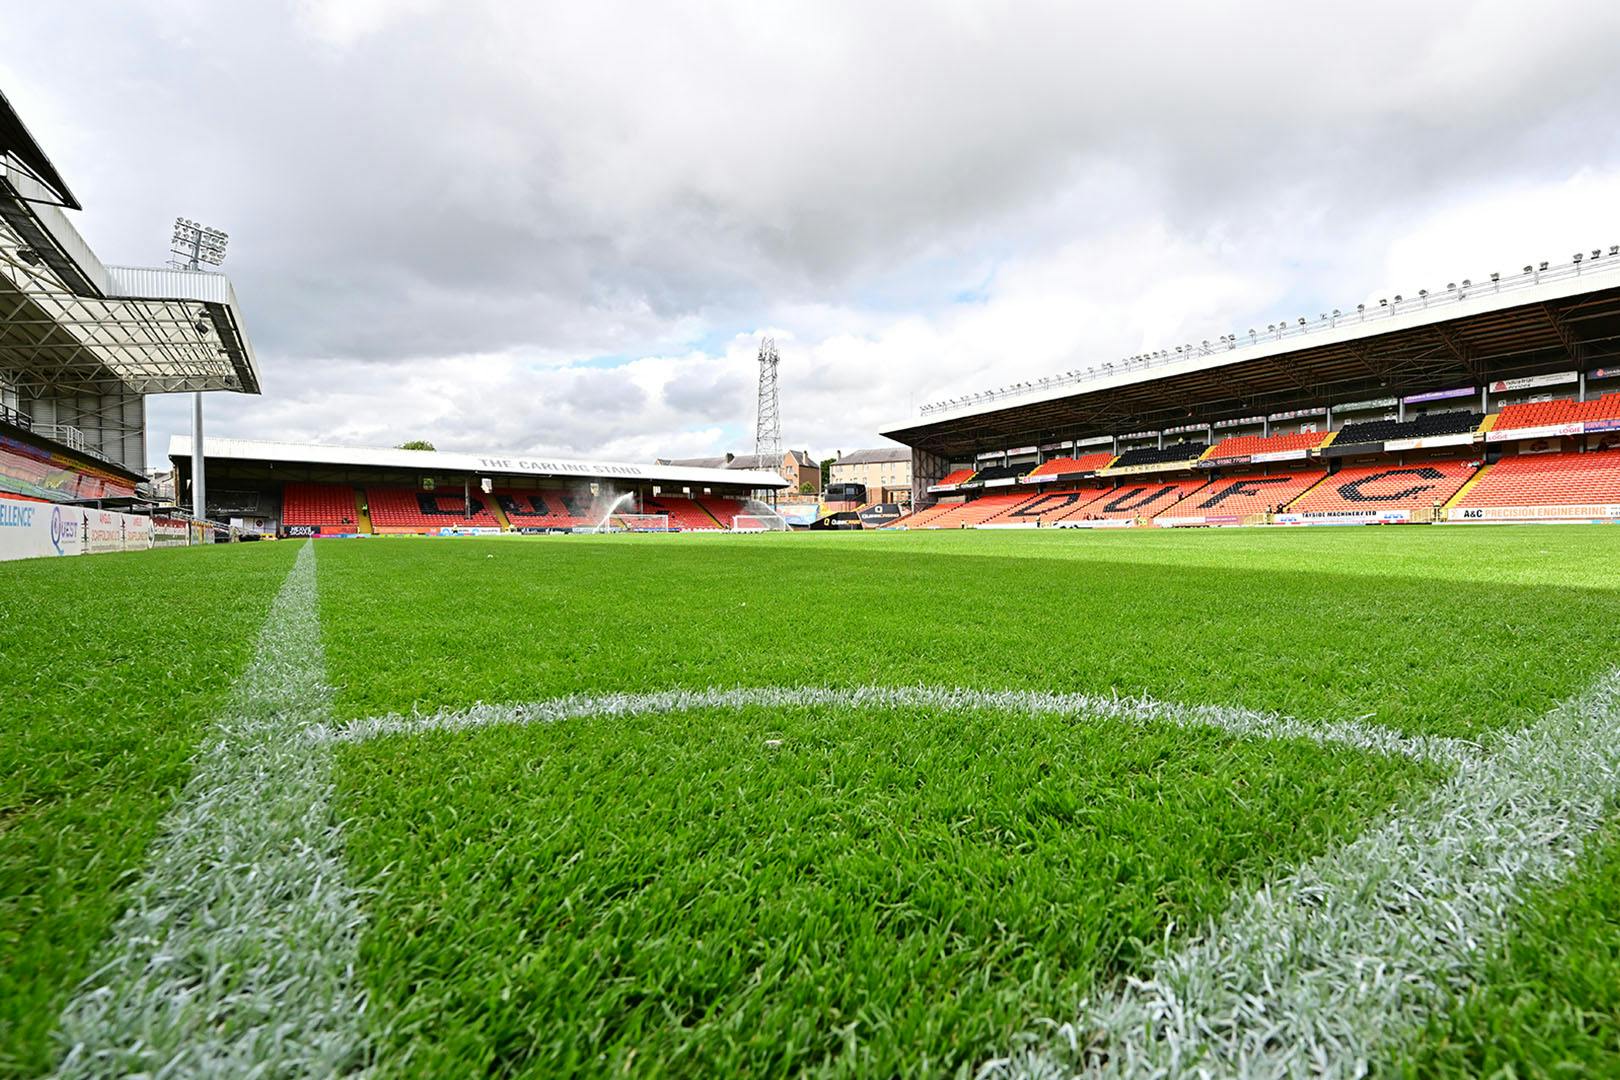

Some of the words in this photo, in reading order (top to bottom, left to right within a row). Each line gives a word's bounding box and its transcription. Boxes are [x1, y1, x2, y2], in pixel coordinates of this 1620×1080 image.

[478, 458, 512, 468] THE
[519, 461, 591, 473] CARLING
[593, 465, 642, 475] STAND
[1463, 509, 1483, 518] A&C
[1485, 508, 1536, 518] PRECISION
[1538, 506, 1607, 516] ENGINEERING
